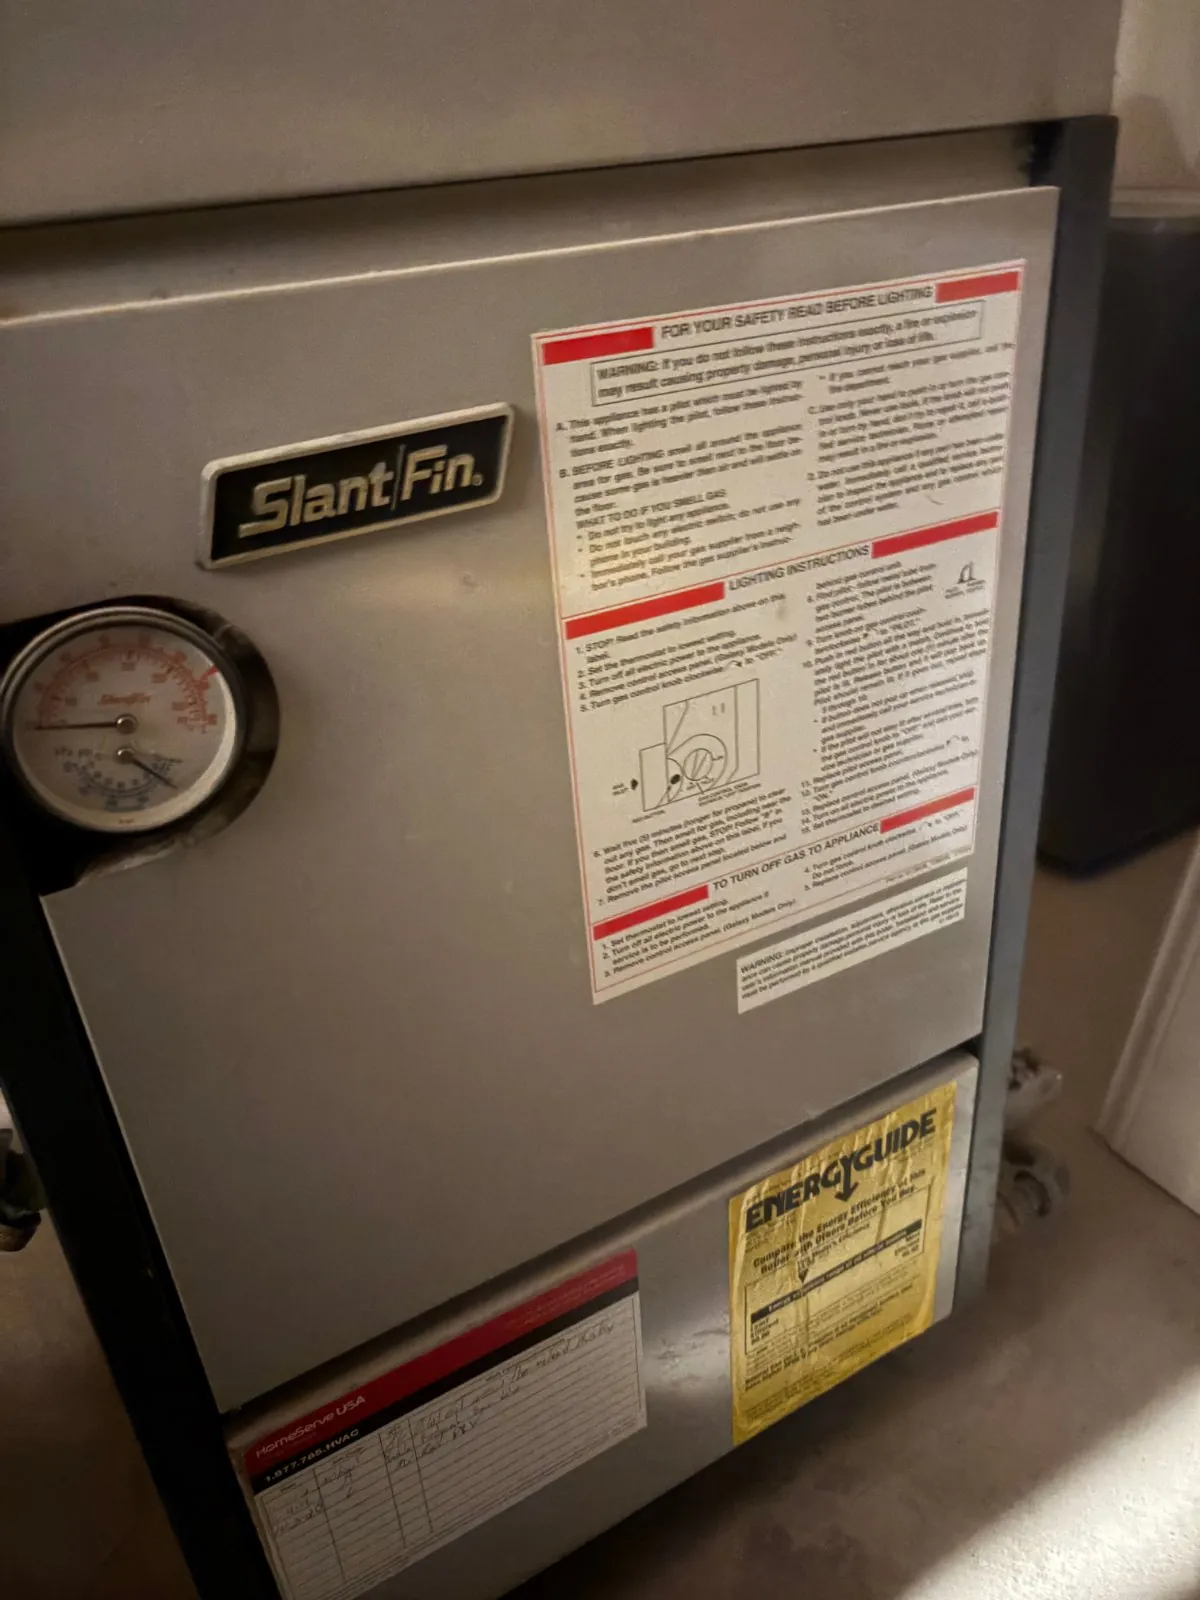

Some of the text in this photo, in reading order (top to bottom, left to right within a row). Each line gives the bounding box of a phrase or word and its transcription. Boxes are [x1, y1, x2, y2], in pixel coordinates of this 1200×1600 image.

[660, 322, 690, 340] FOR
[694, 315, 731, 335] YOUR
[825, 292, 874, 313] BEFORE
[728, 544, 869, 591] LIGHTING INSTRUCTIONS
[712, 821, 879, 891] TO TURN OFF GAS TO APPLIANCE
[746, 1108, 937, 1232] ENERGYGUIDE
[256, 1395, 366, 1458] HomeServe USA
